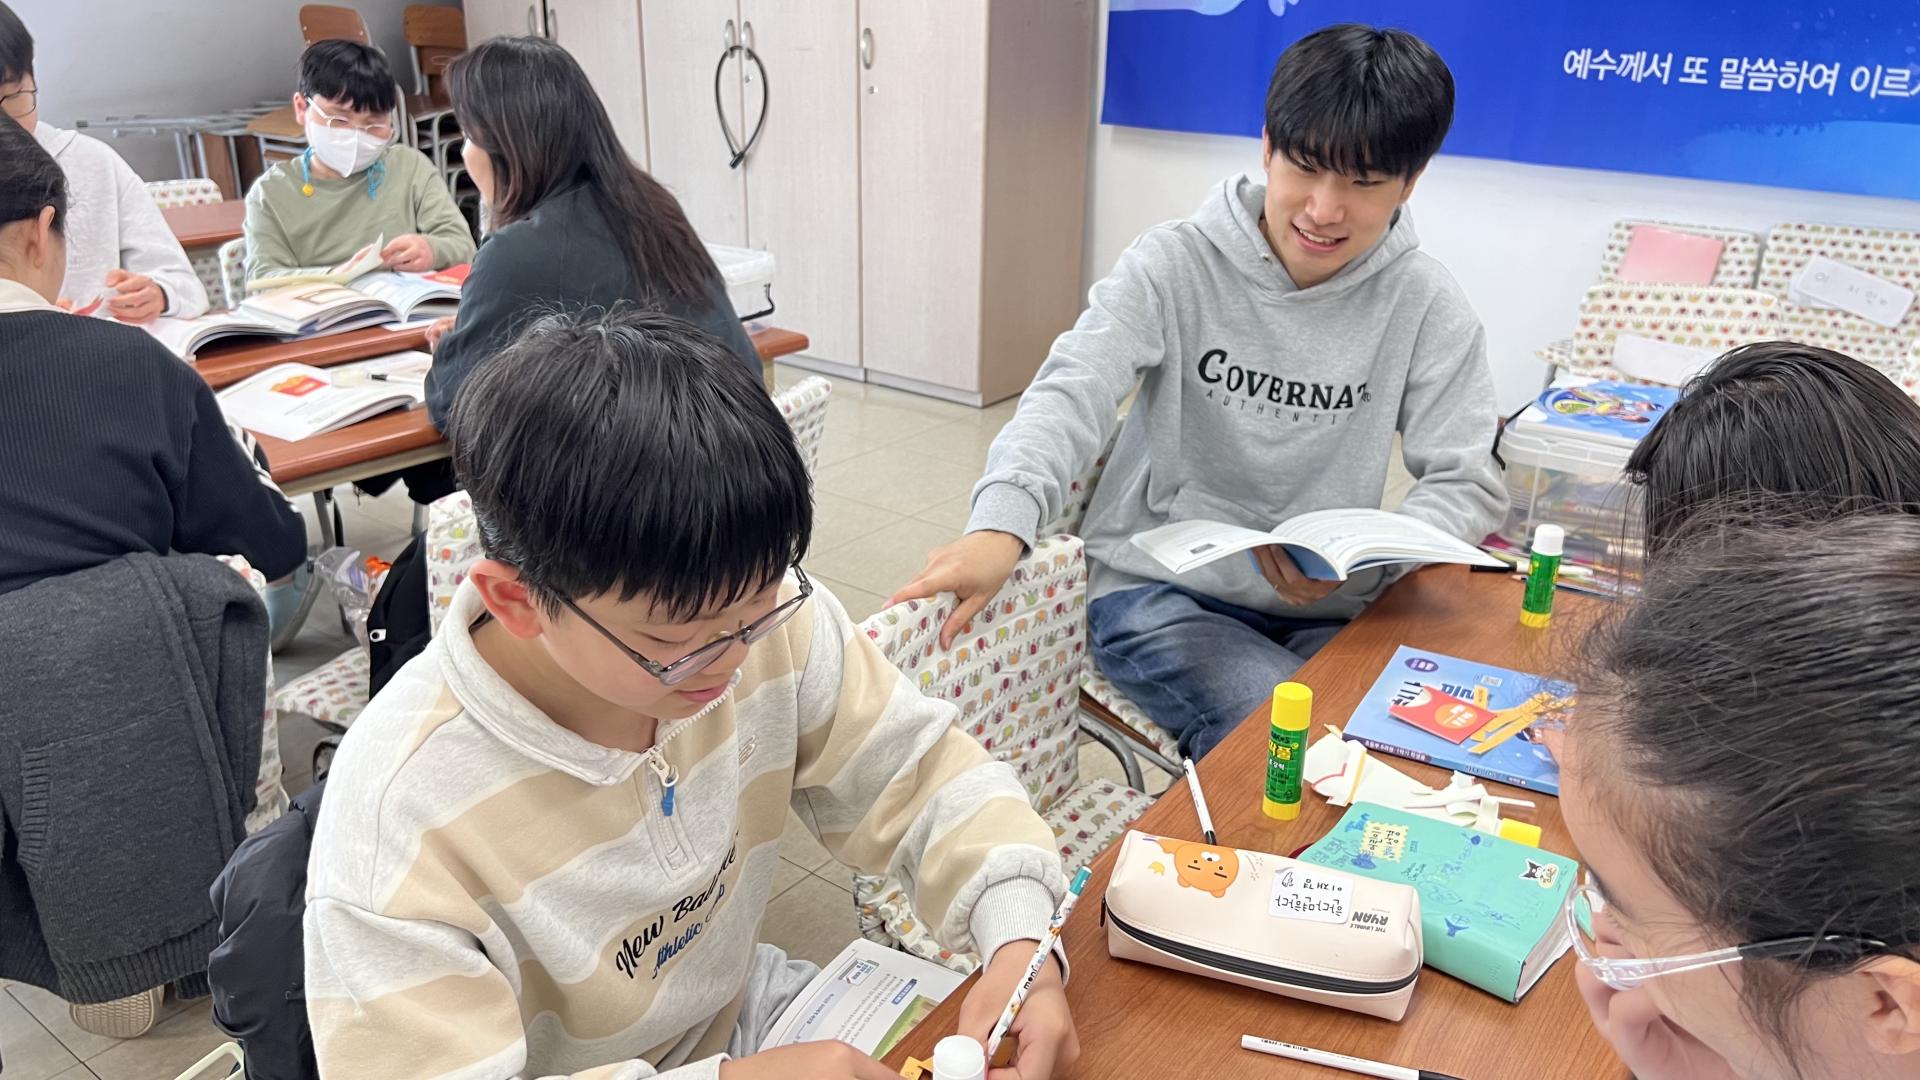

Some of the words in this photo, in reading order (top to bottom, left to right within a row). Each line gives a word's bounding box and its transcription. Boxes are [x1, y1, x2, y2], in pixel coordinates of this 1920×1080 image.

[1563, 48, 1673, 85] 예수께서
[1679, 57, 1709, 85] 또
[1719, 57, 1840, 96] 말씀하여
[1351, 911, 1389, 926] RYAN
[616, 915, 664, 979] New
[652, 922, 703, 980] Athletic
